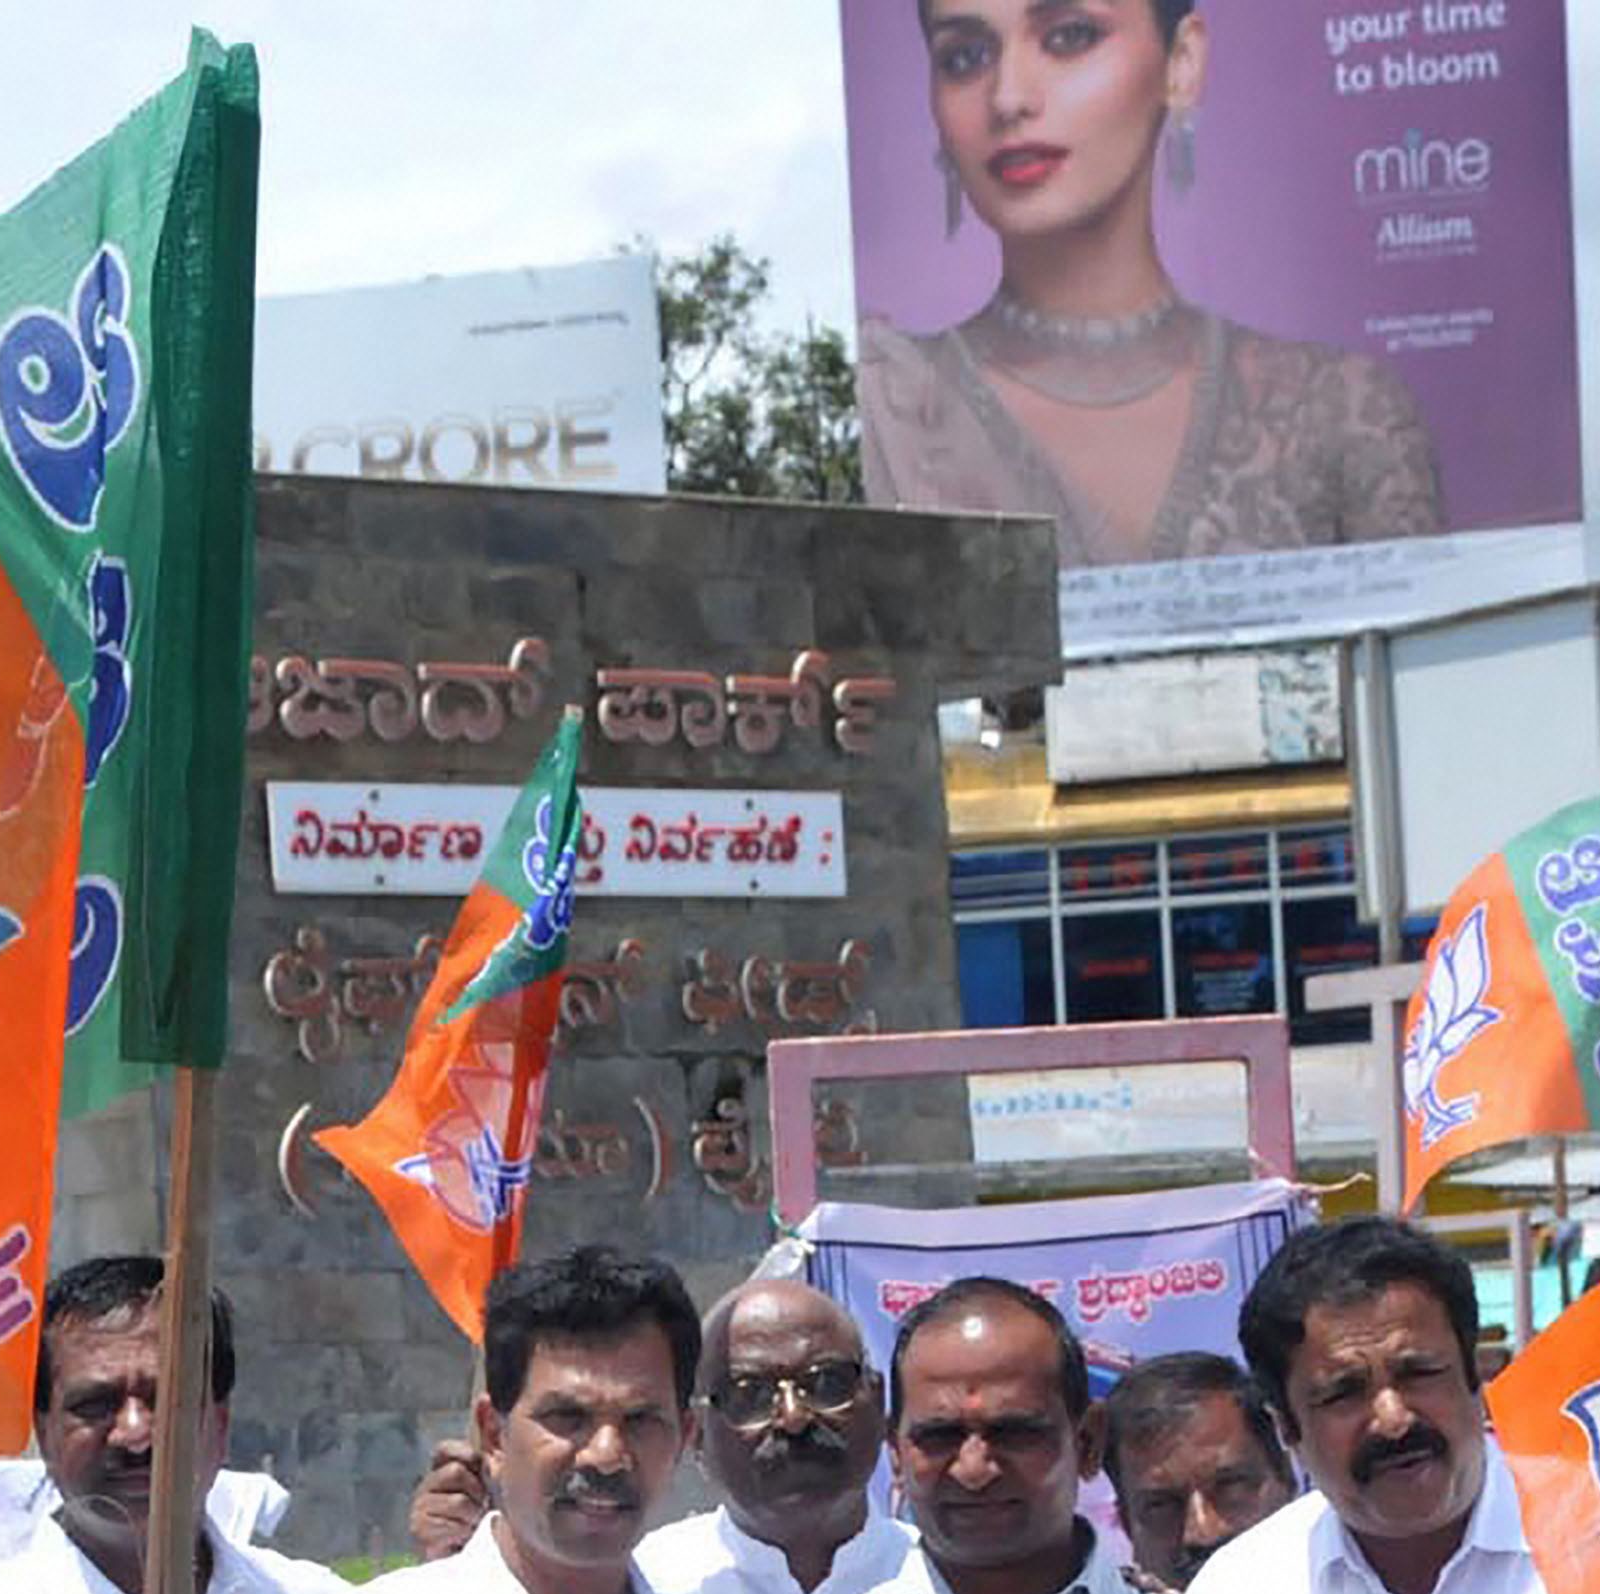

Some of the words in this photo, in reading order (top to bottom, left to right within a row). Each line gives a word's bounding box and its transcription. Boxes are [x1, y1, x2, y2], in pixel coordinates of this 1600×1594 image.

[1325, 8, 1413, 56] your
[1422, 0, 1506, 34] time
[1335, 62, 1373, 94] to
[1381, 49, 1500, 89] bloom
[1354, 128, 1492, 192] mine
